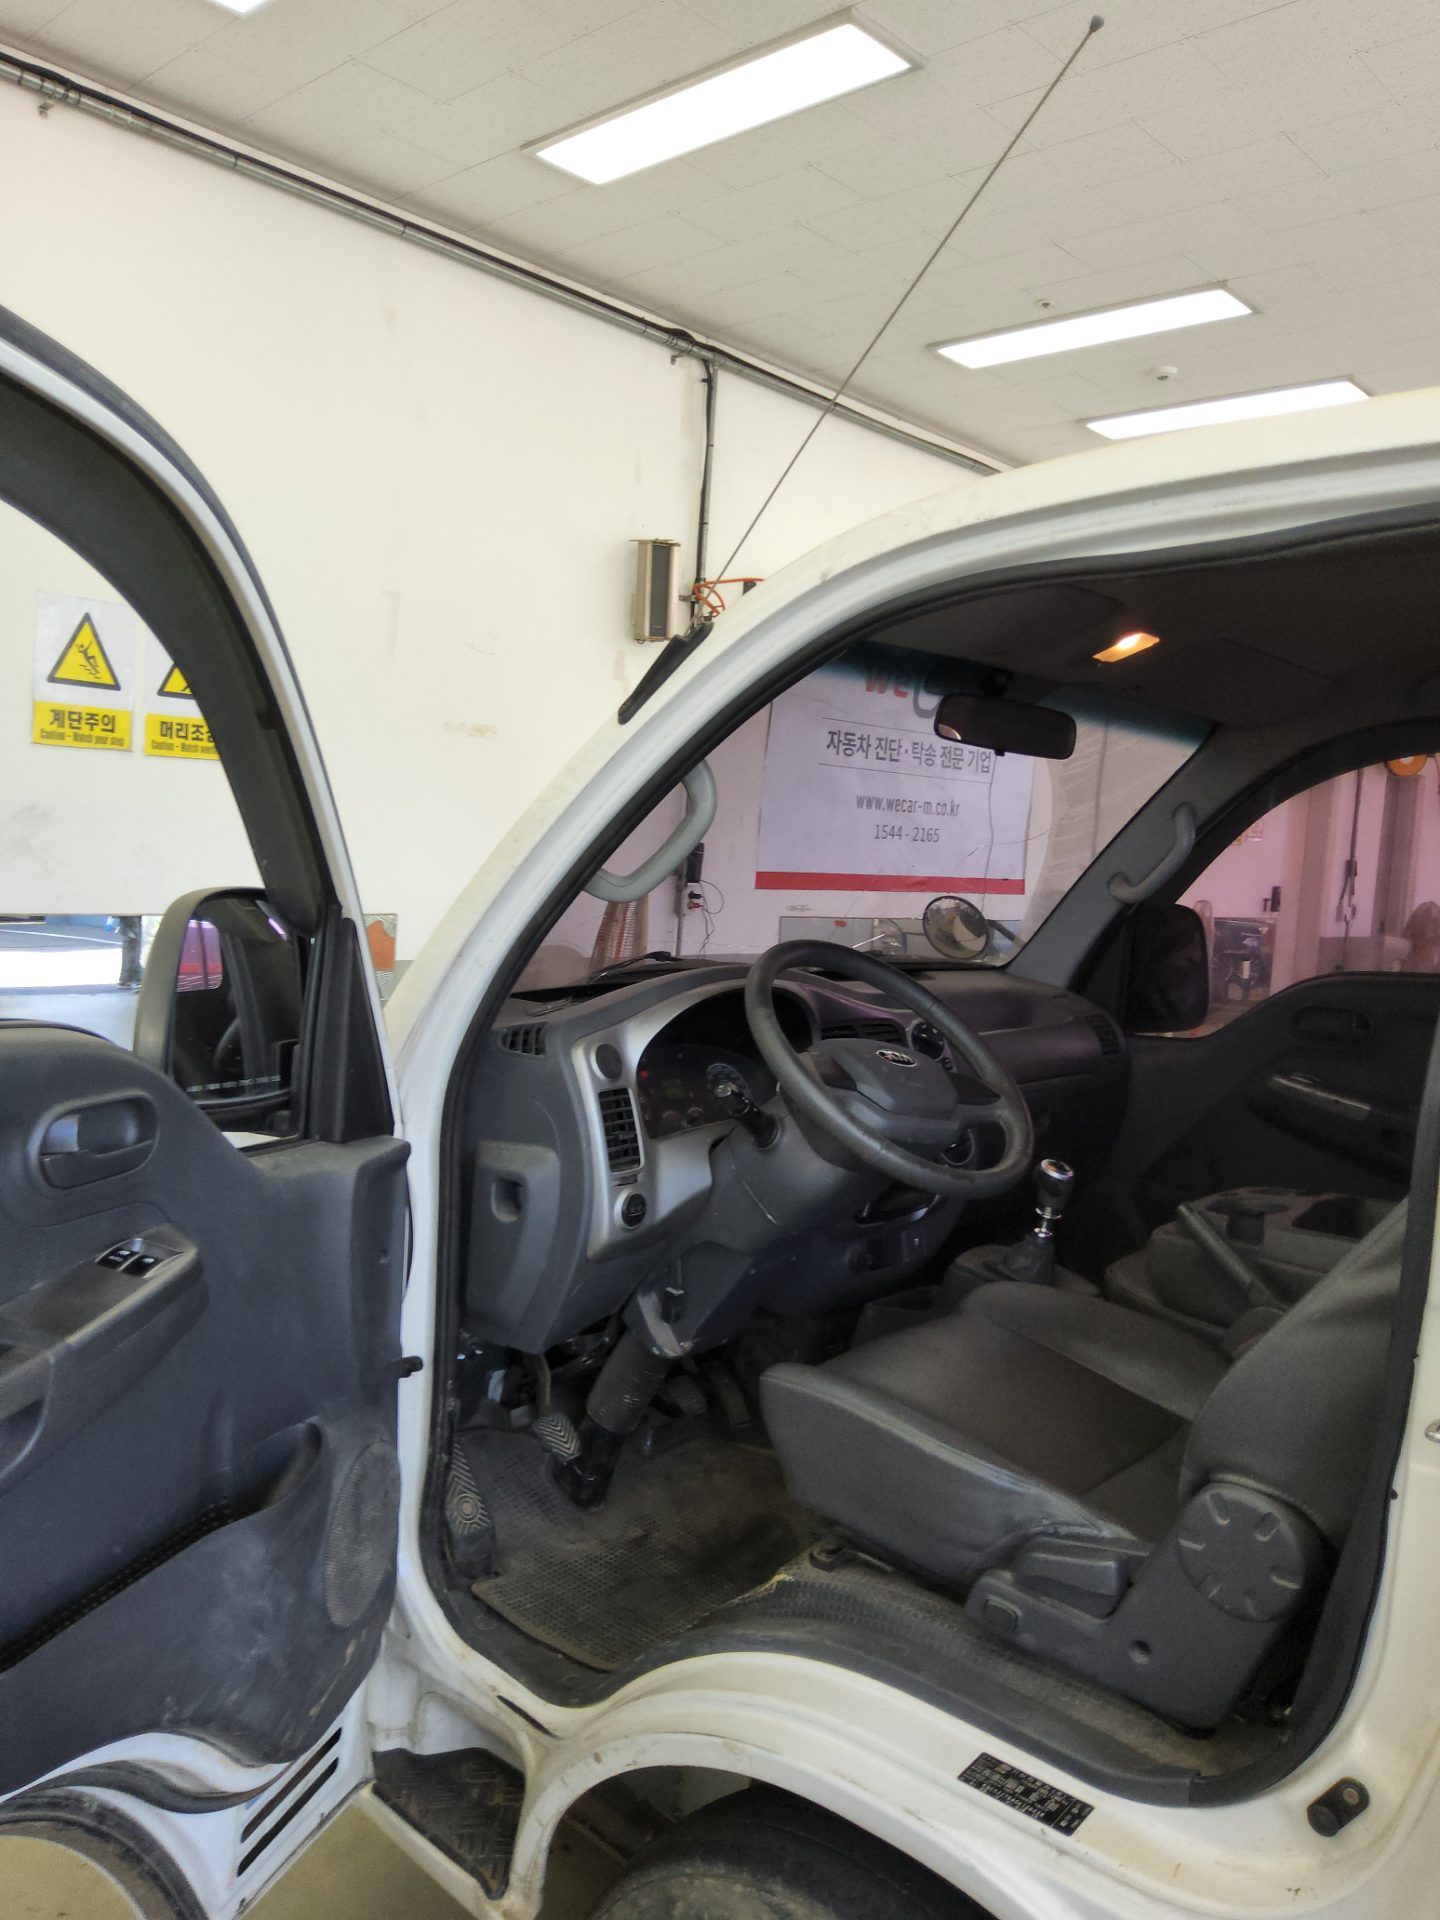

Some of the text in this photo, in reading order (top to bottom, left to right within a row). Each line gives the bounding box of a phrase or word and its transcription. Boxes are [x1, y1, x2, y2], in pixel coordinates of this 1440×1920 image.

[50, 709, 116, 733] 계단주의
[827, 730, 871, 759] 자동차
[940, 745, 964, 770] 전문
[968, 749, 992, 774] 기업
[856, 795, 960, 817] www.wecar-m.co.kr
